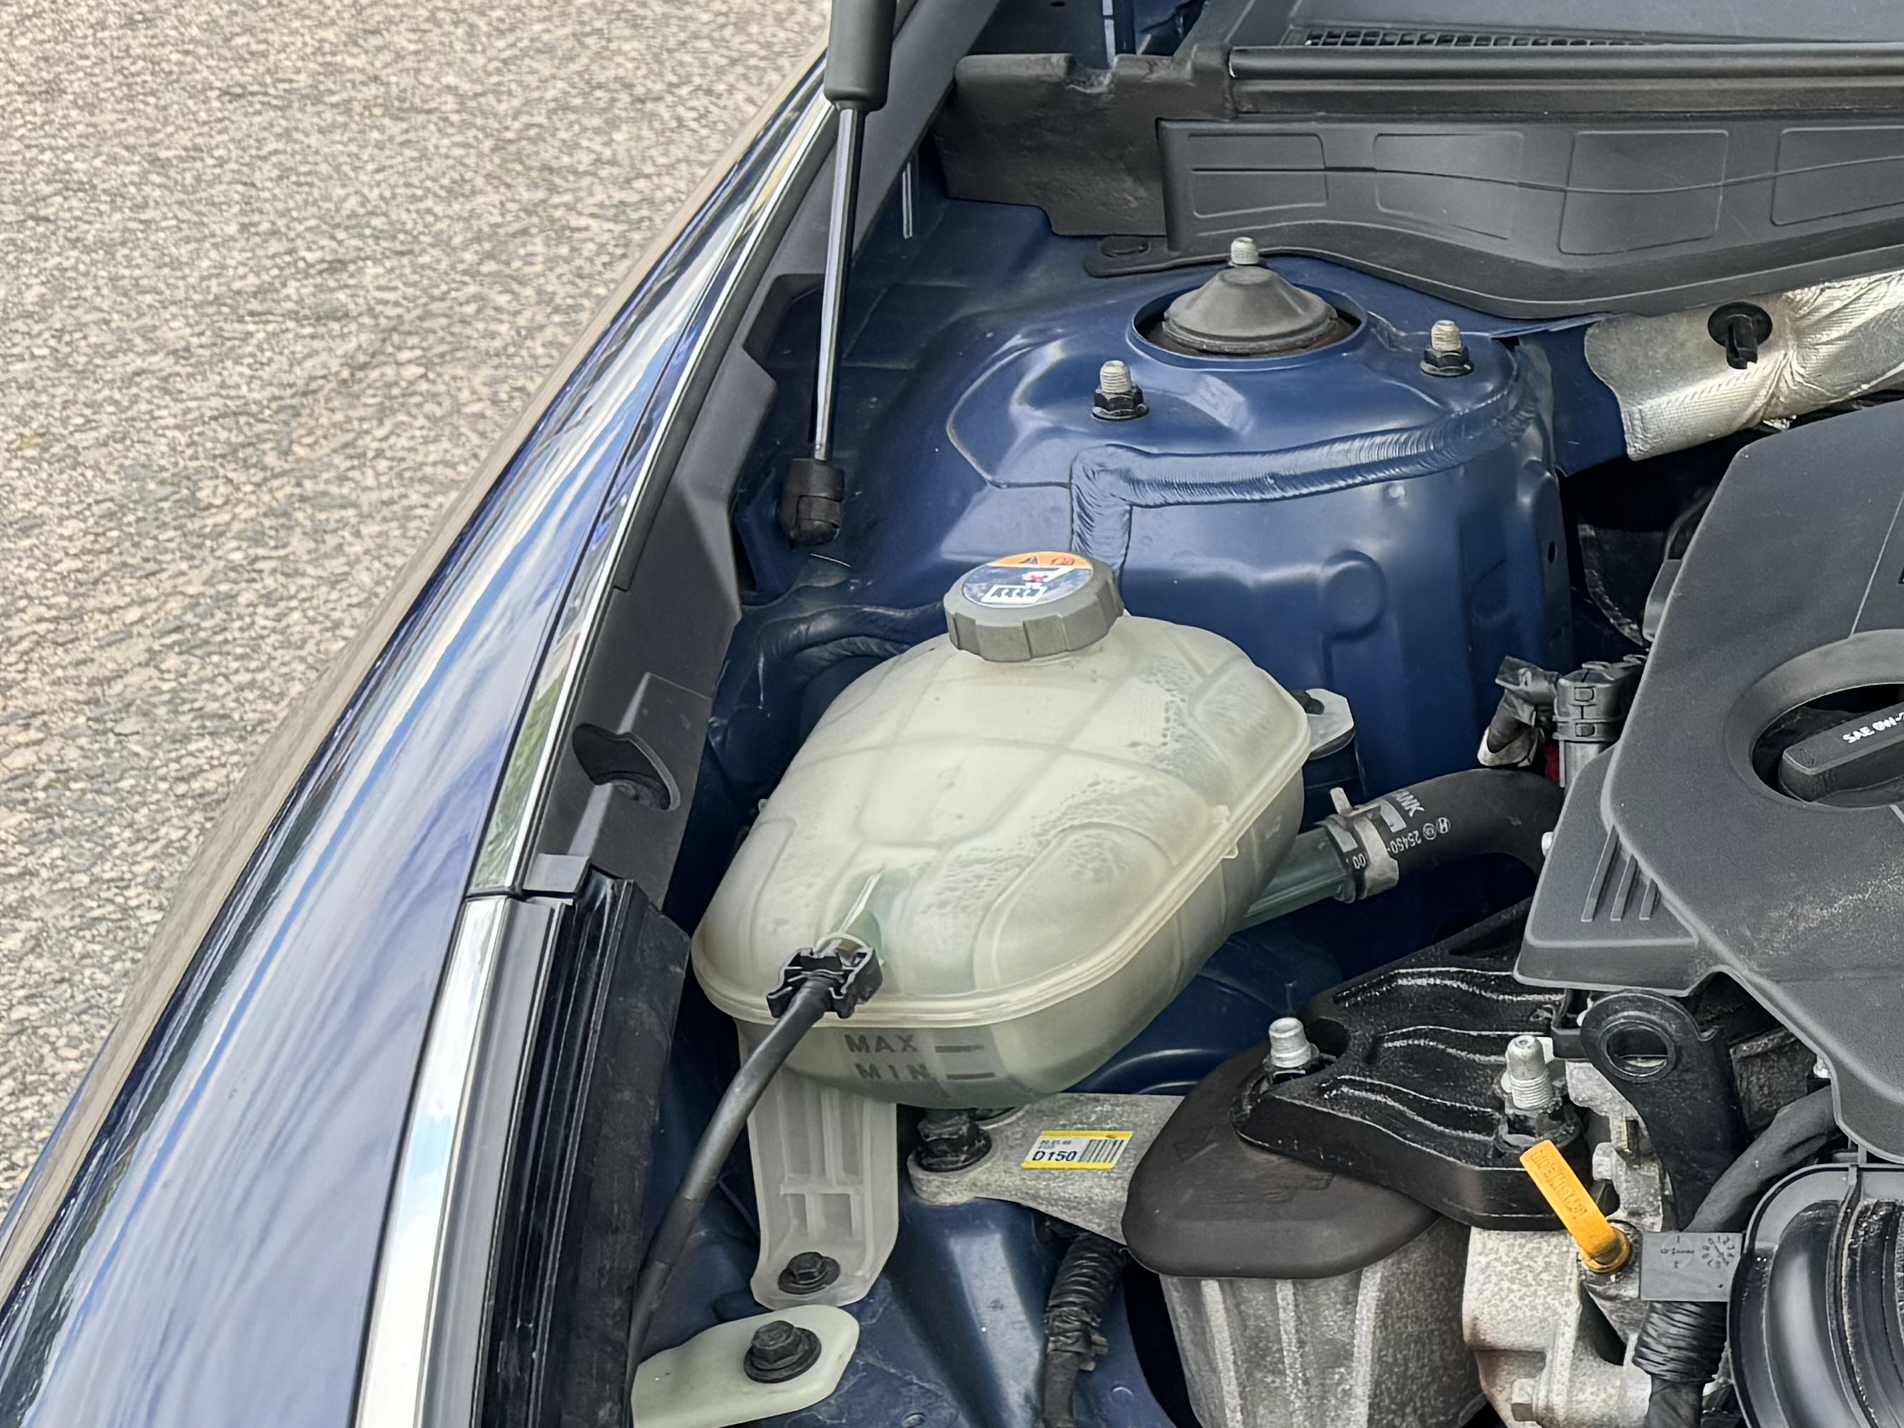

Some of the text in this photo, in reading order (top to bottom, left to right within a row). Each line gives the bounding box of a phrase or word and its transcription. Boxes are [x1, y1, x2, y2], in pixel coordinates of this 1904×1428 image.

[1842, 725, 1875, 744] SAE
[844, 1034, 919, 1054] MAX
[855, 1063, 931, 1081] MIN
[1032, 1149, 1078, 1163] D150
